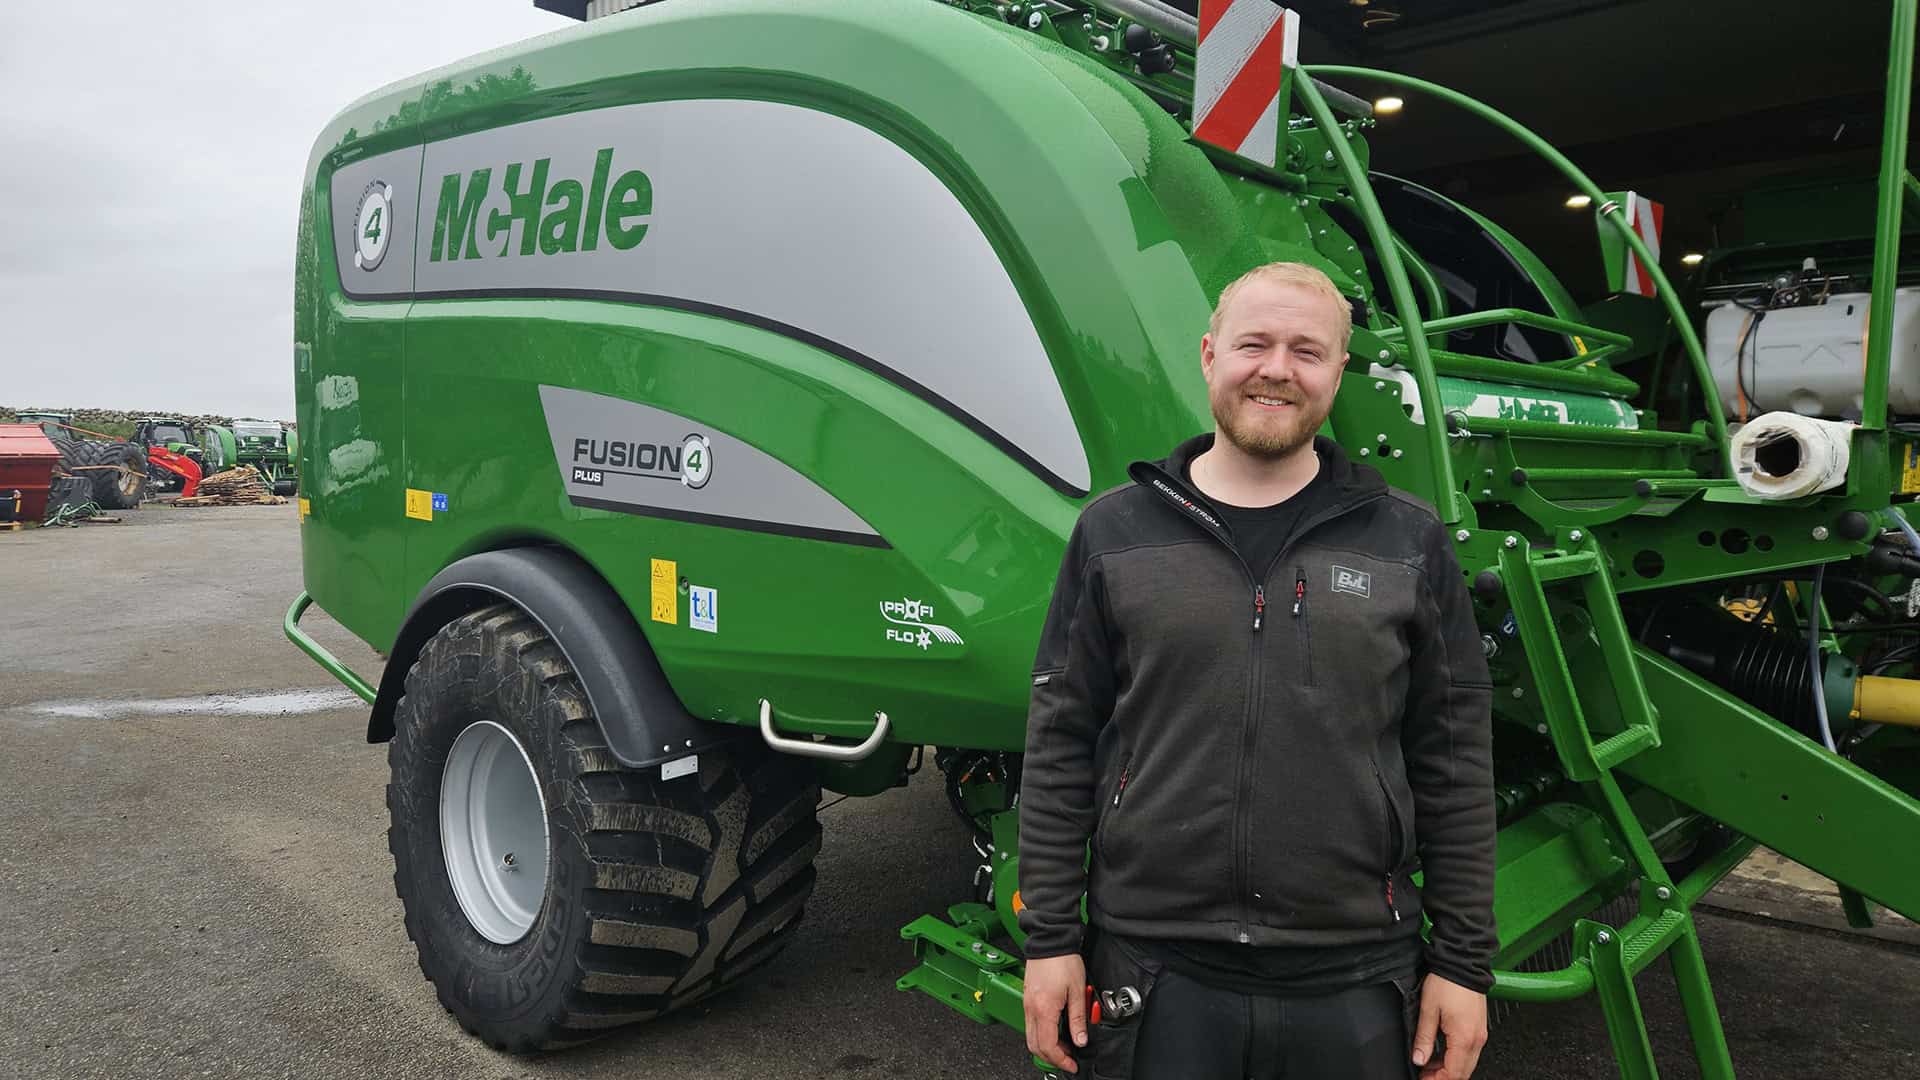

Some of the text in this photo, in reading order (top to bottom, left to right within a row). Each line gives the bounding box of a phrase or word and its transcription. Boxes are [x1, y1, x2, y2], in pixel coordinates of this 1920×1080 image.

[430, 147, 653, 263] McHale
[363, 207, 382, 245] 4
[573, 438, 703, 473] FUSION 4
[574, 470, 602, 482] PLUS
[692, 591, 715, 621] t&l
[884, 597, 934, 621] PROFI
